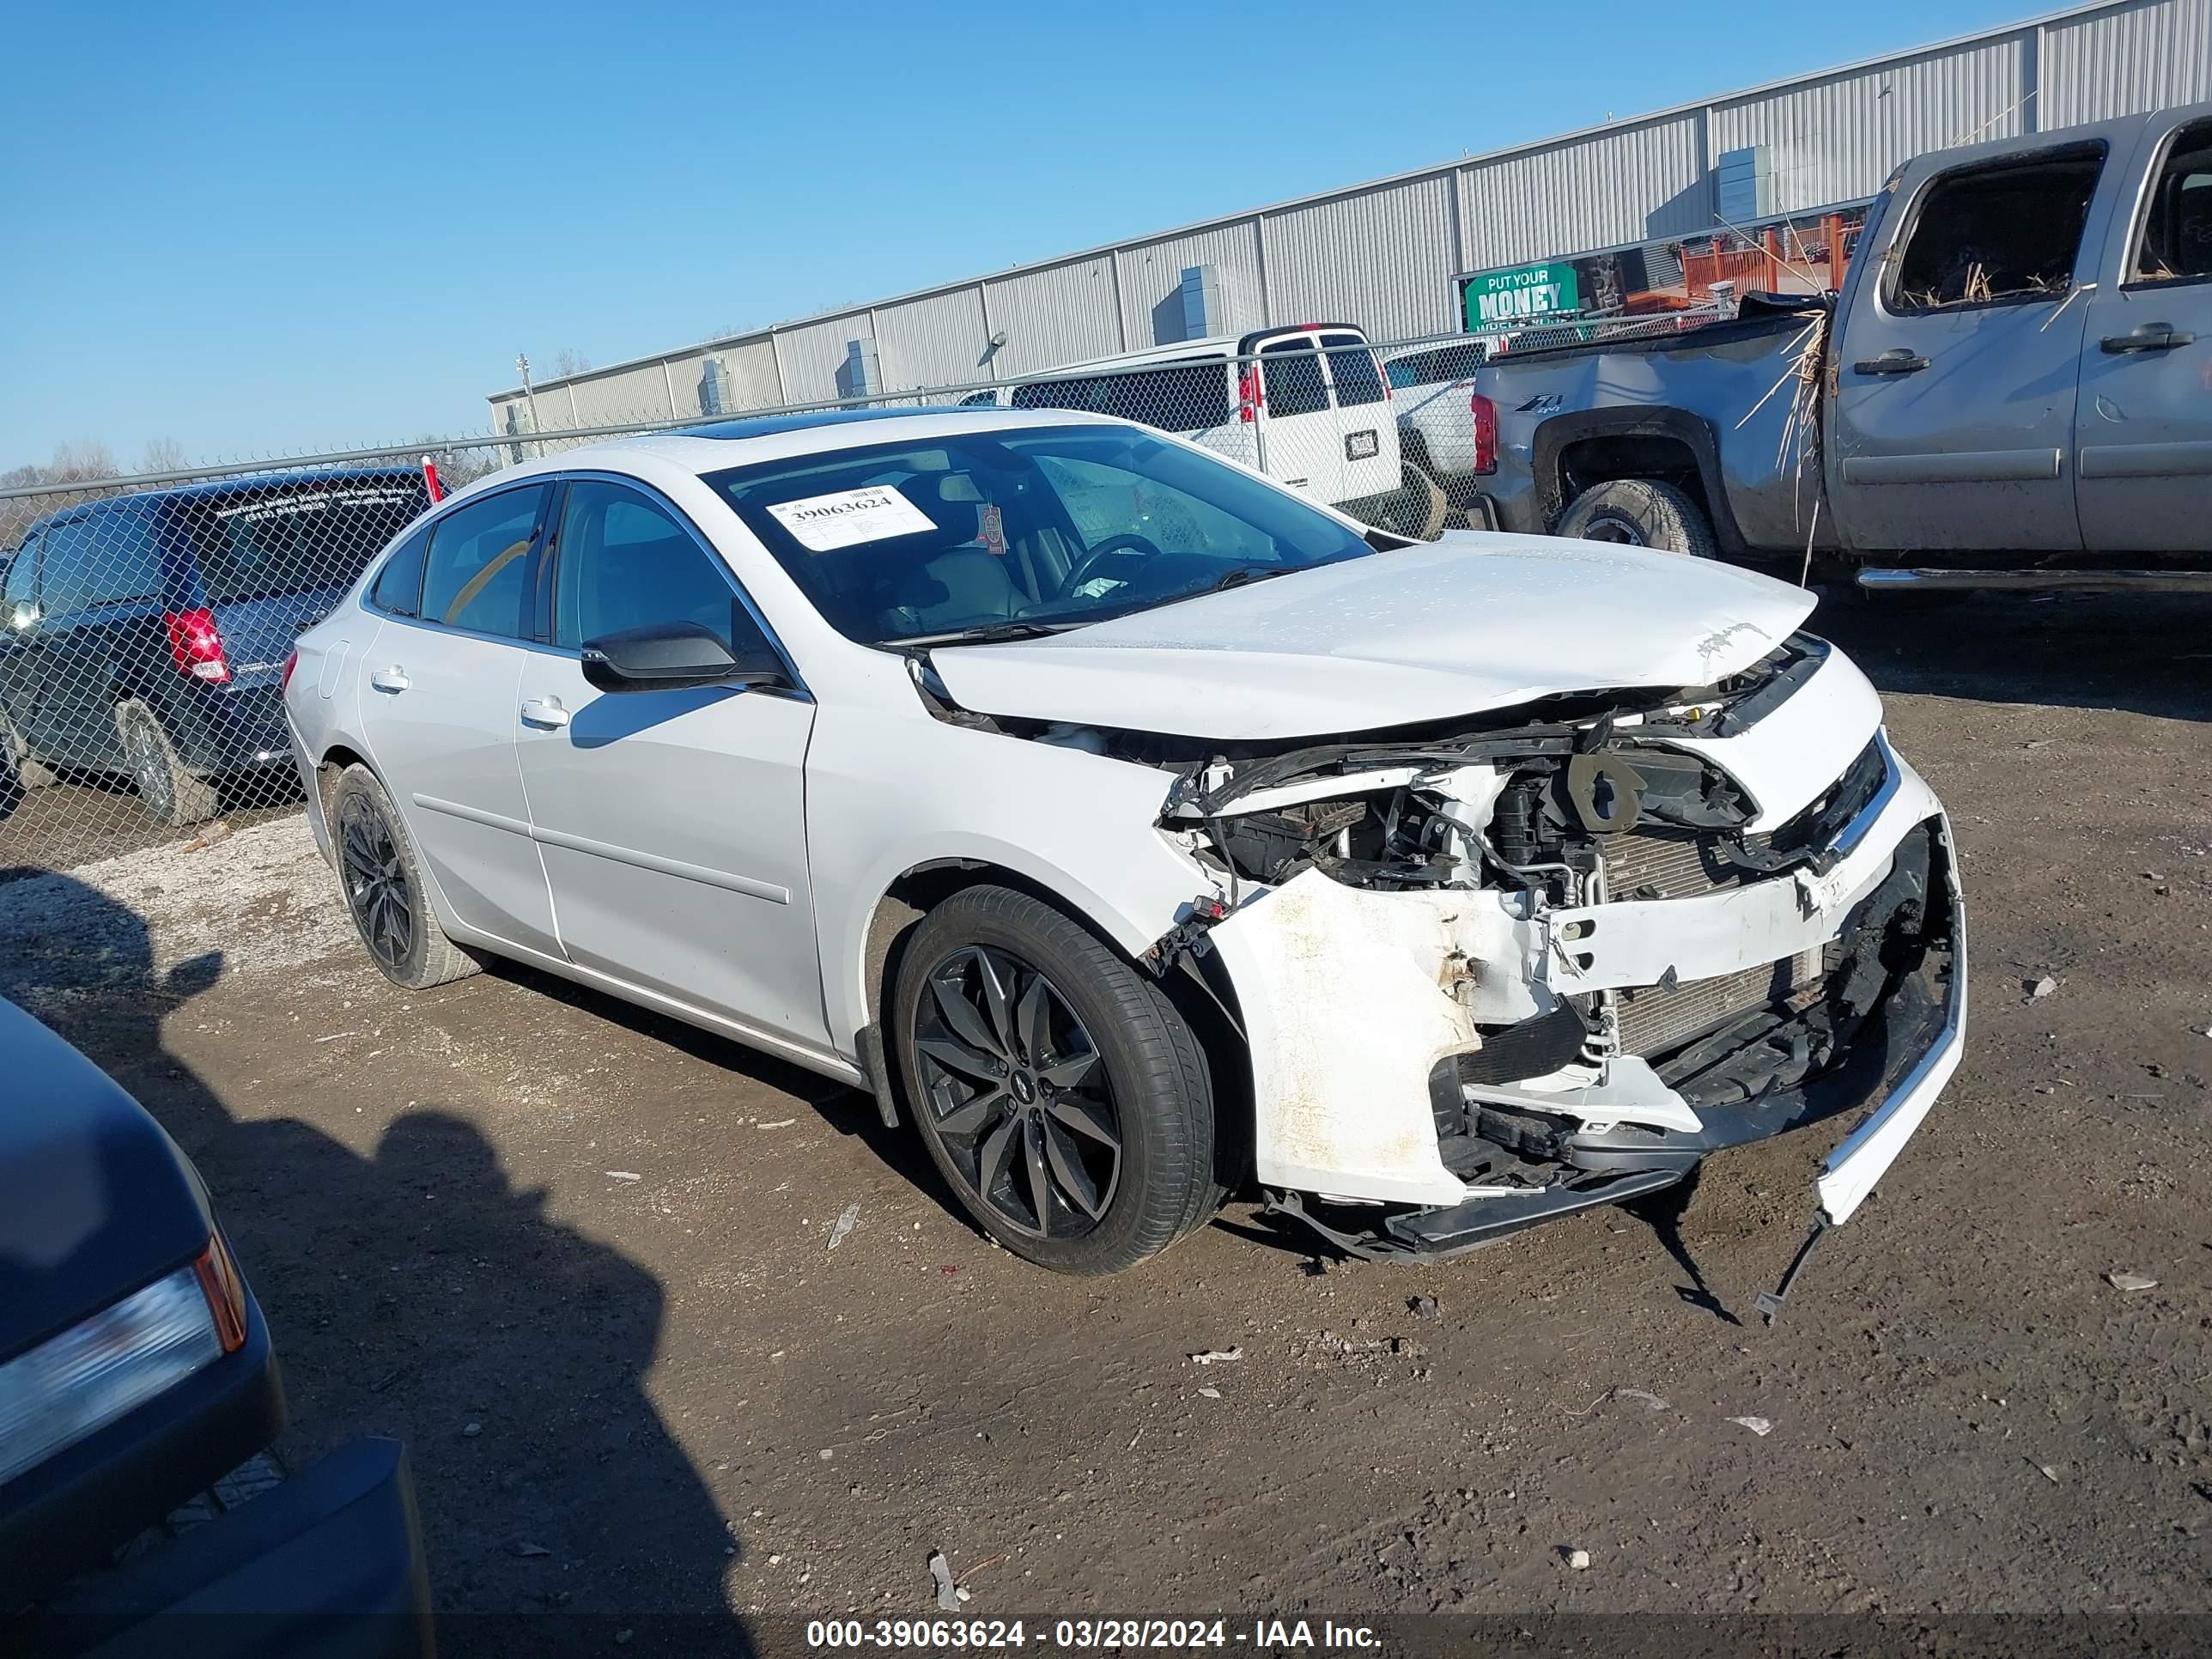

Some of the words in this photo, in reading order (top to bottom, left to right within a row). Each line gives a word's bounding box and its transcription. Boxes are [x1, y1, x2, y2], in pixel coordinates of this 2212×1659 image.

[1488, 276, 1511, 290] PUT
[1513, 270, 1548, 287] YOUR
[1478, 282, 1561, 320] MONEY
[1514, 394, 1564, 413] Z71
[216, 503, 264, 518] American
[264, 497, 297, 508] Indian
[297, 491, 330, 503] Health
[350, 488, 380, 496] Family
[790, 496, 892, 522] 39063624
